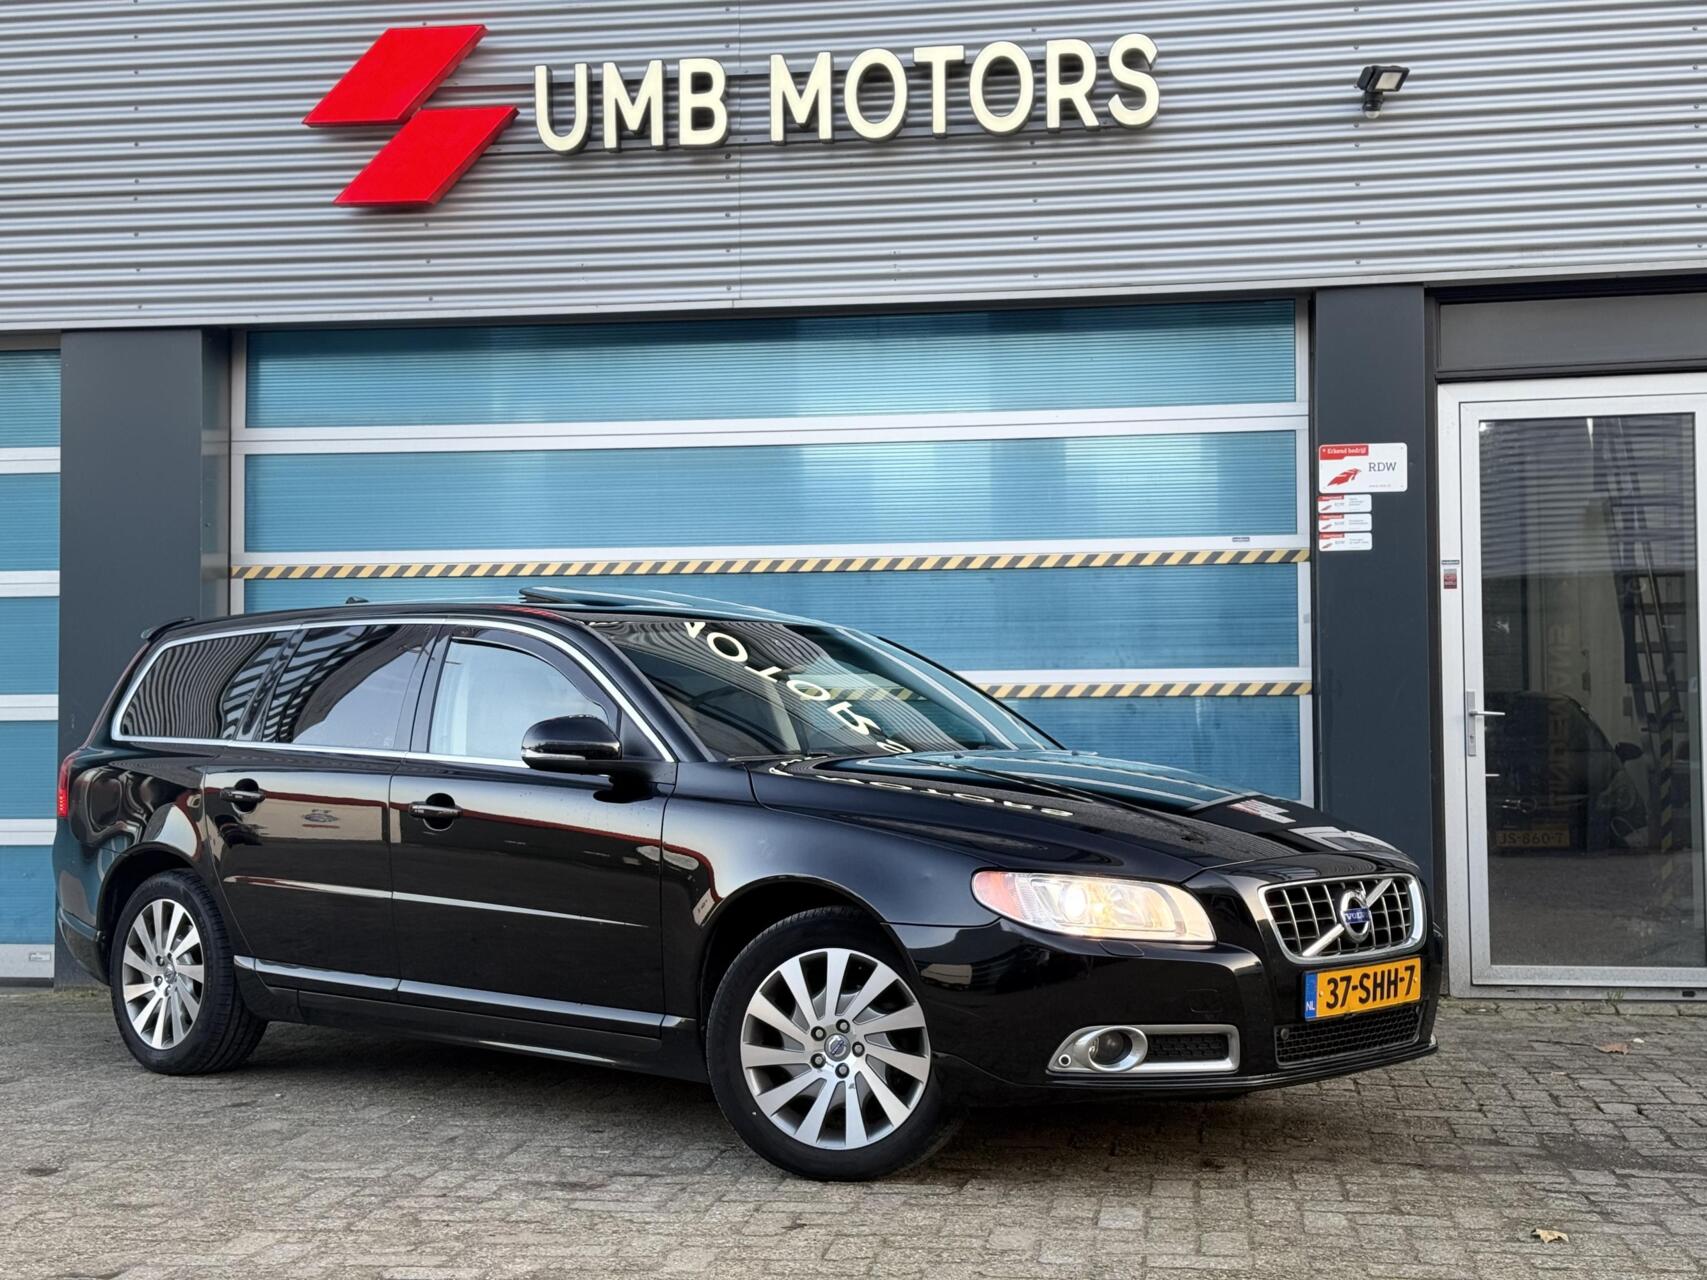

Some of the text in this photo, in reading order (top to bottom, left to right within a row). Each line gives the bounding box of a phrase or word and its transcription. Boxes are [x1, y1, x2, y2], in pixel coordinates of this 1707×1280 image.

[534, 33, 1160, 153] UMB MOTORS
[1368, 462, 1397, 472] RDW
[1344, 911, 1368, 920] VOLV
[1326, 965, 1416, 1009] 37-SHH-7
[1306, 1001, 1316, 1011] NL
